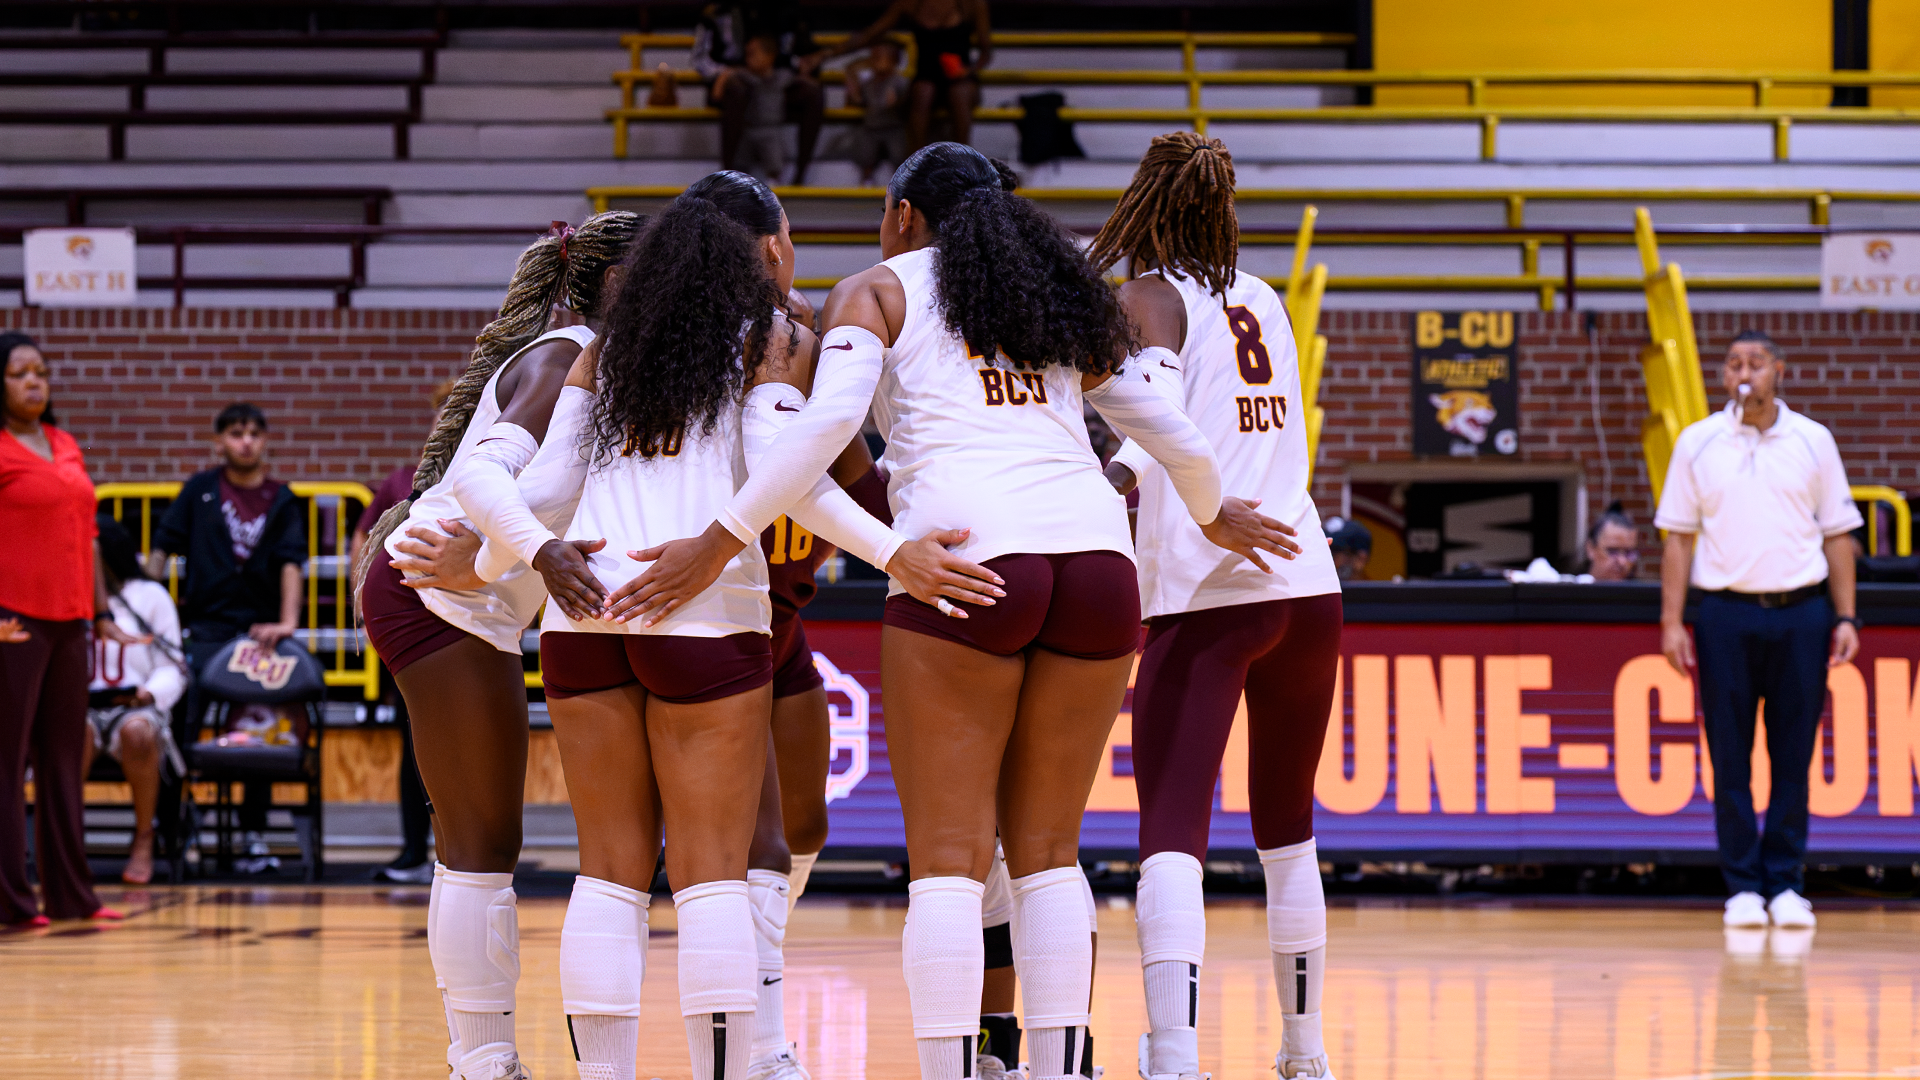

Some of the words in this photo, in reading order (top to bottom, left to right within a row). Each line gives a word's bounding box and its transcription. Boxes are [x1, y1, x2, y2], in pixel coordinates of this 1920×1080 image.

[35, 269, 99, 292] EAST
[1830, 274, 1898, 297] EAST
[1223, 303, 1274, 386] 8
[1416, 310, 1515, 348] B-CU
[978, 368, 1048, 406] BCU
[1235, 395, 1287, 433] BCU
